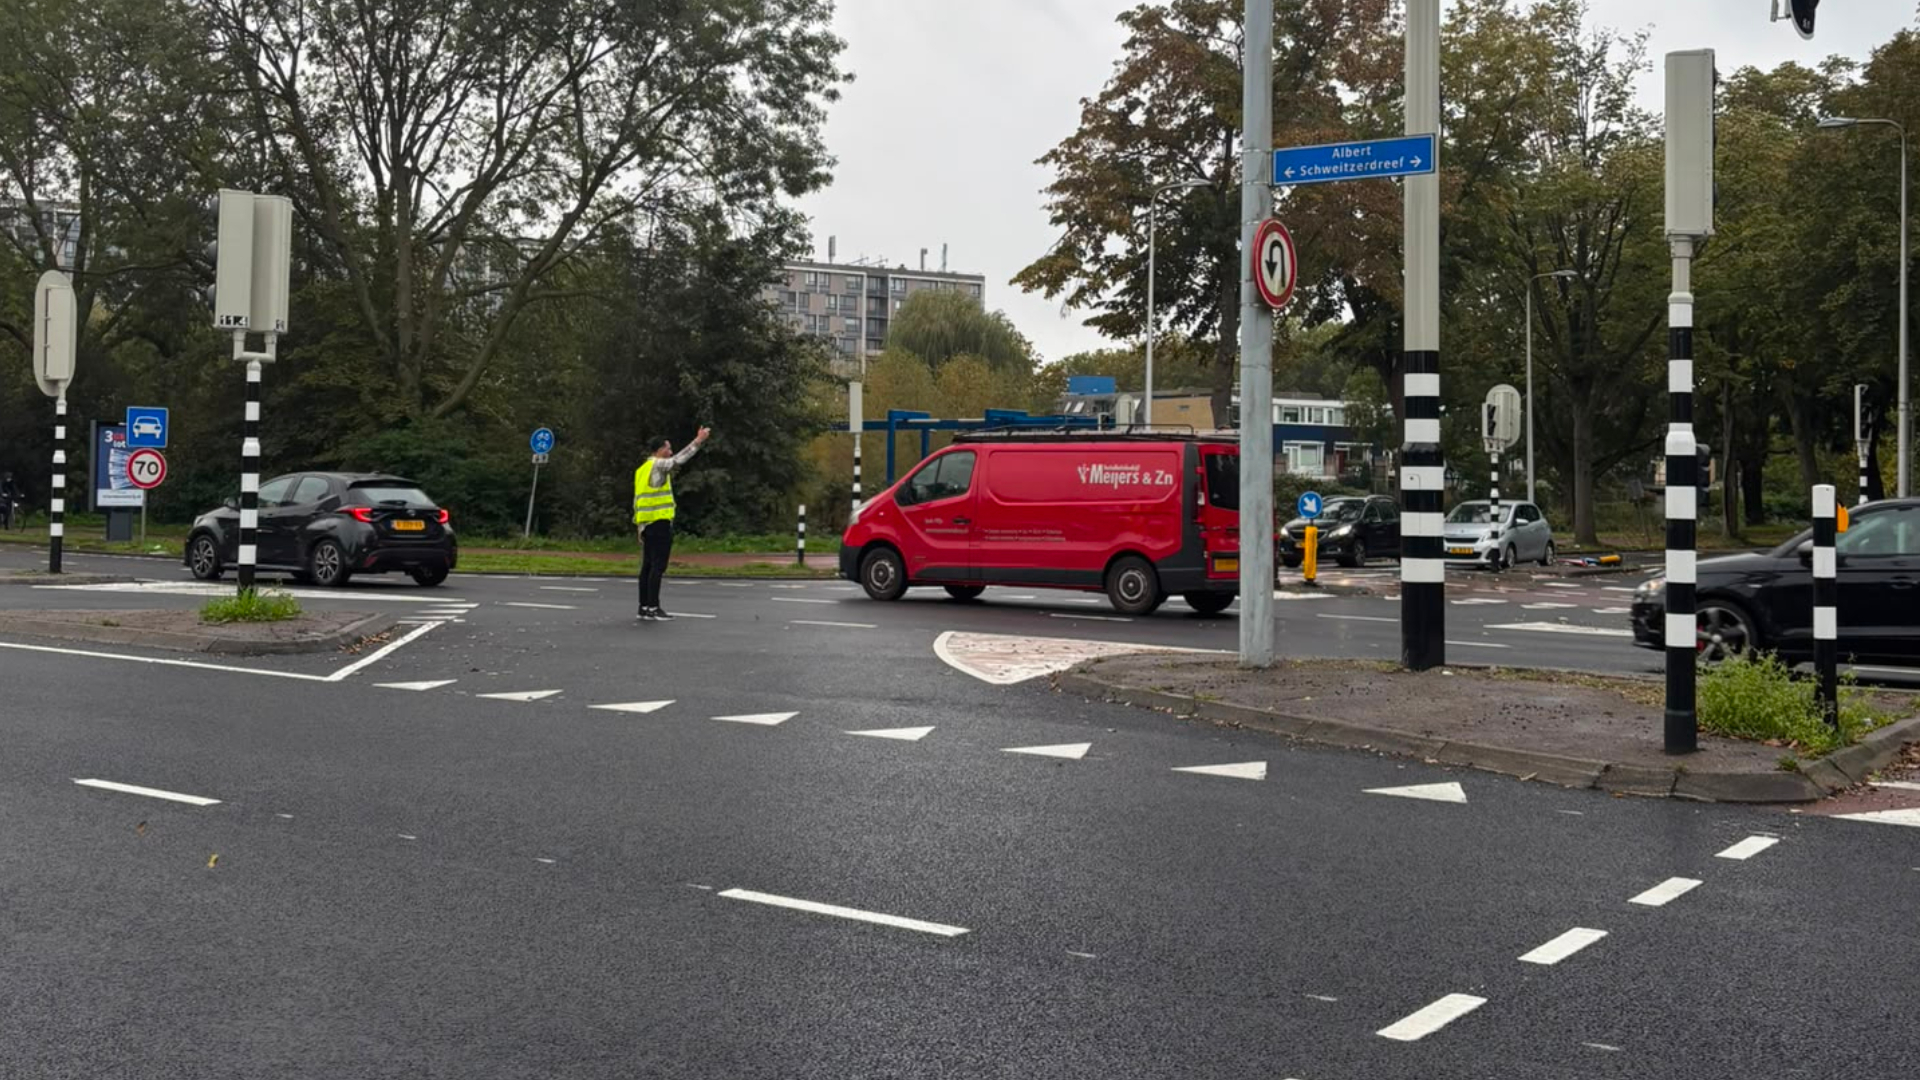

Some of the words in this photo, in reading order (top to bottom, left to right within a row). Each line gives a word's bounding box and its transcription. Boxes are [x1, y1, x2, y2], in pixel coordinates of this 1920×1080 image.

[1332, 146, 1371, 159] Albert
[1300, 156, 1404, 176] Schweitzerdreef
[104, 430, 114, 443] 3
[134, 461, 159, 476] 70
[1142, 471, 1152, 485] &
[1154, 470, 1173, 485] Zn
